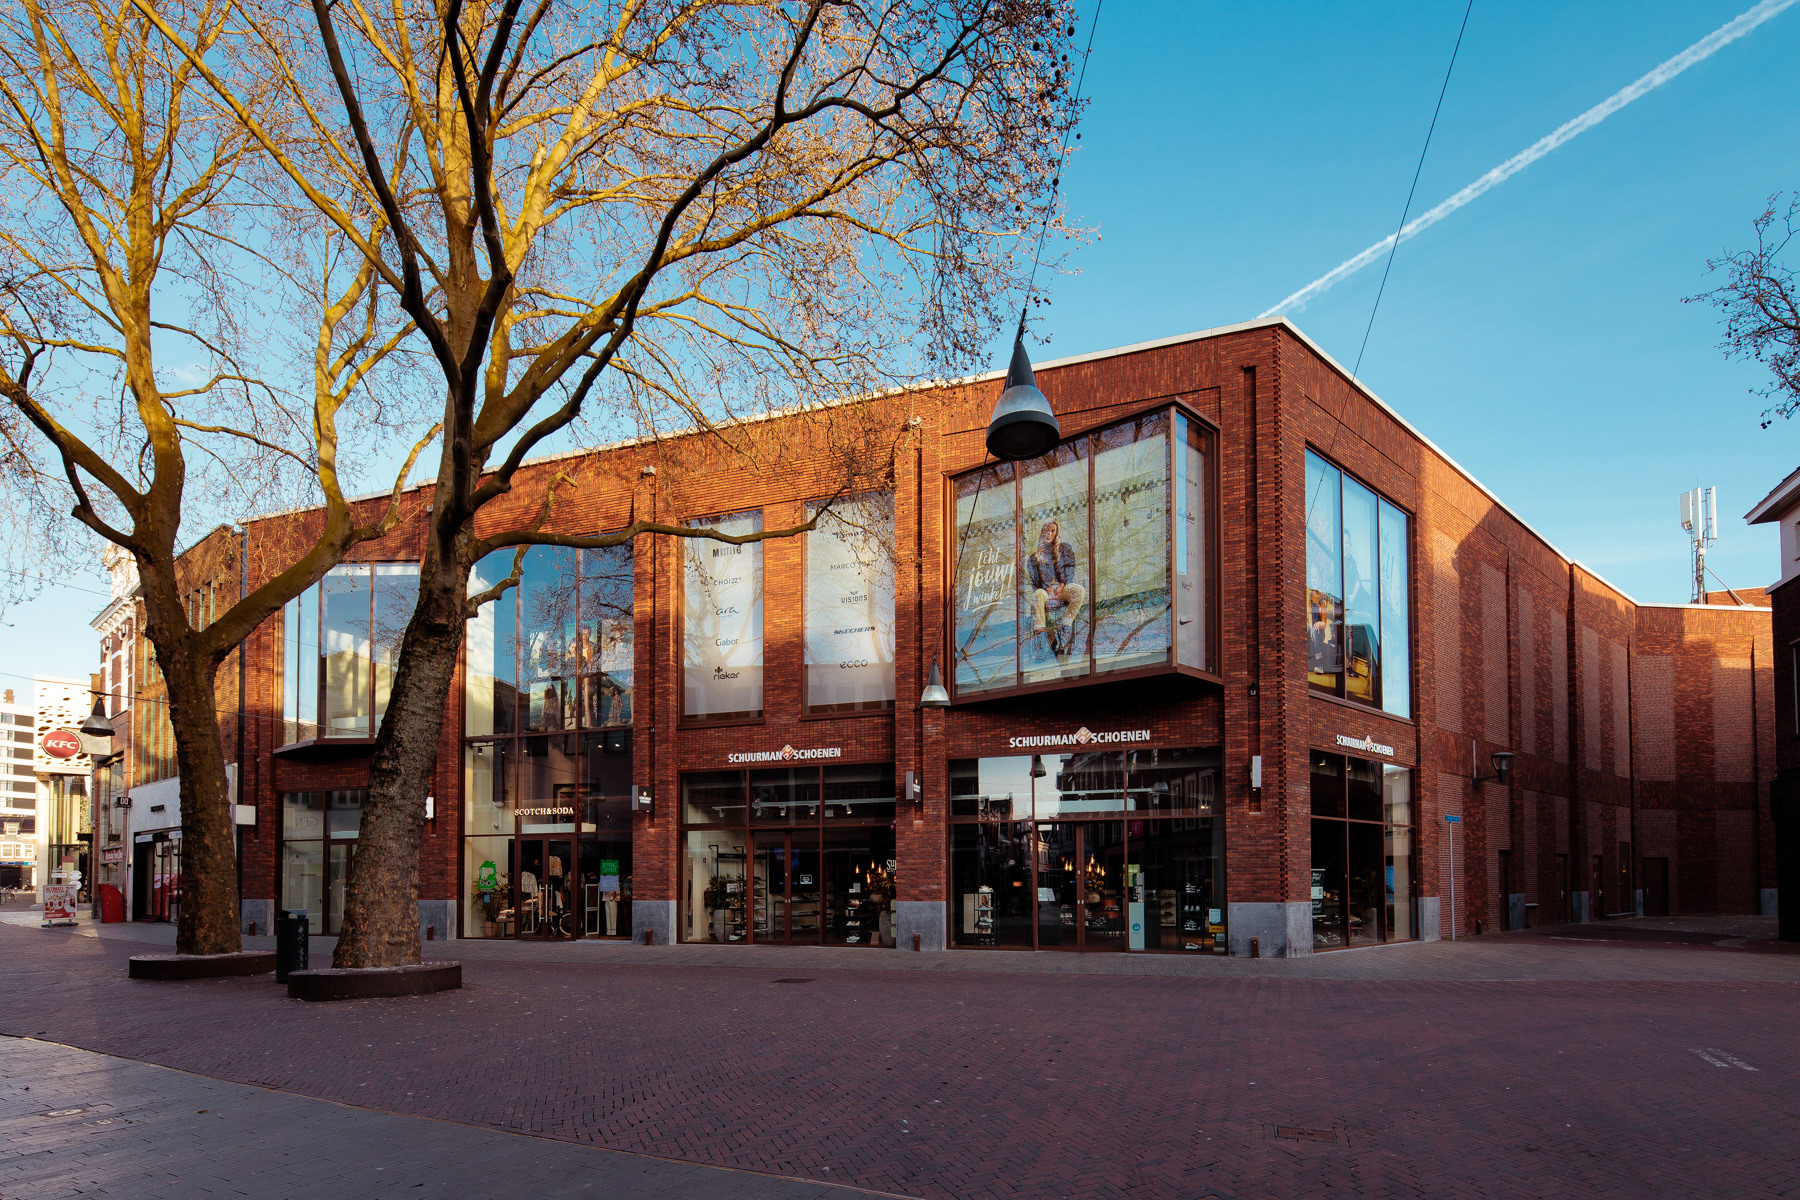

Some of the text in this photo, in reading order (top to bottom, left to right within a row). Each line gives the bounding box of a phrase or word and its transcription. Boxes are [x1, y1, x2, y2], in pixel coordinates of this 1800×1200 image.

[715, 606, 740, 616] ara
[833, 626, 876, 635] SKECHERS
[715, 637, 739, 647] Gabor
[840, 659, 869, 669] ecco
[714, 670, 741, 681] rieker
[1009, 729, 1151, 748] SCHUURMAN SCHOENEN
[46, 739, 78, 750] KFC
[1336, 734, 1394, 757] SCHUURMAN SCHOENEN
[728, 747, 841, 763] SCHUURMAN SCHOENEN
[514, 806, 575, 816] SCOTCH&SODA
